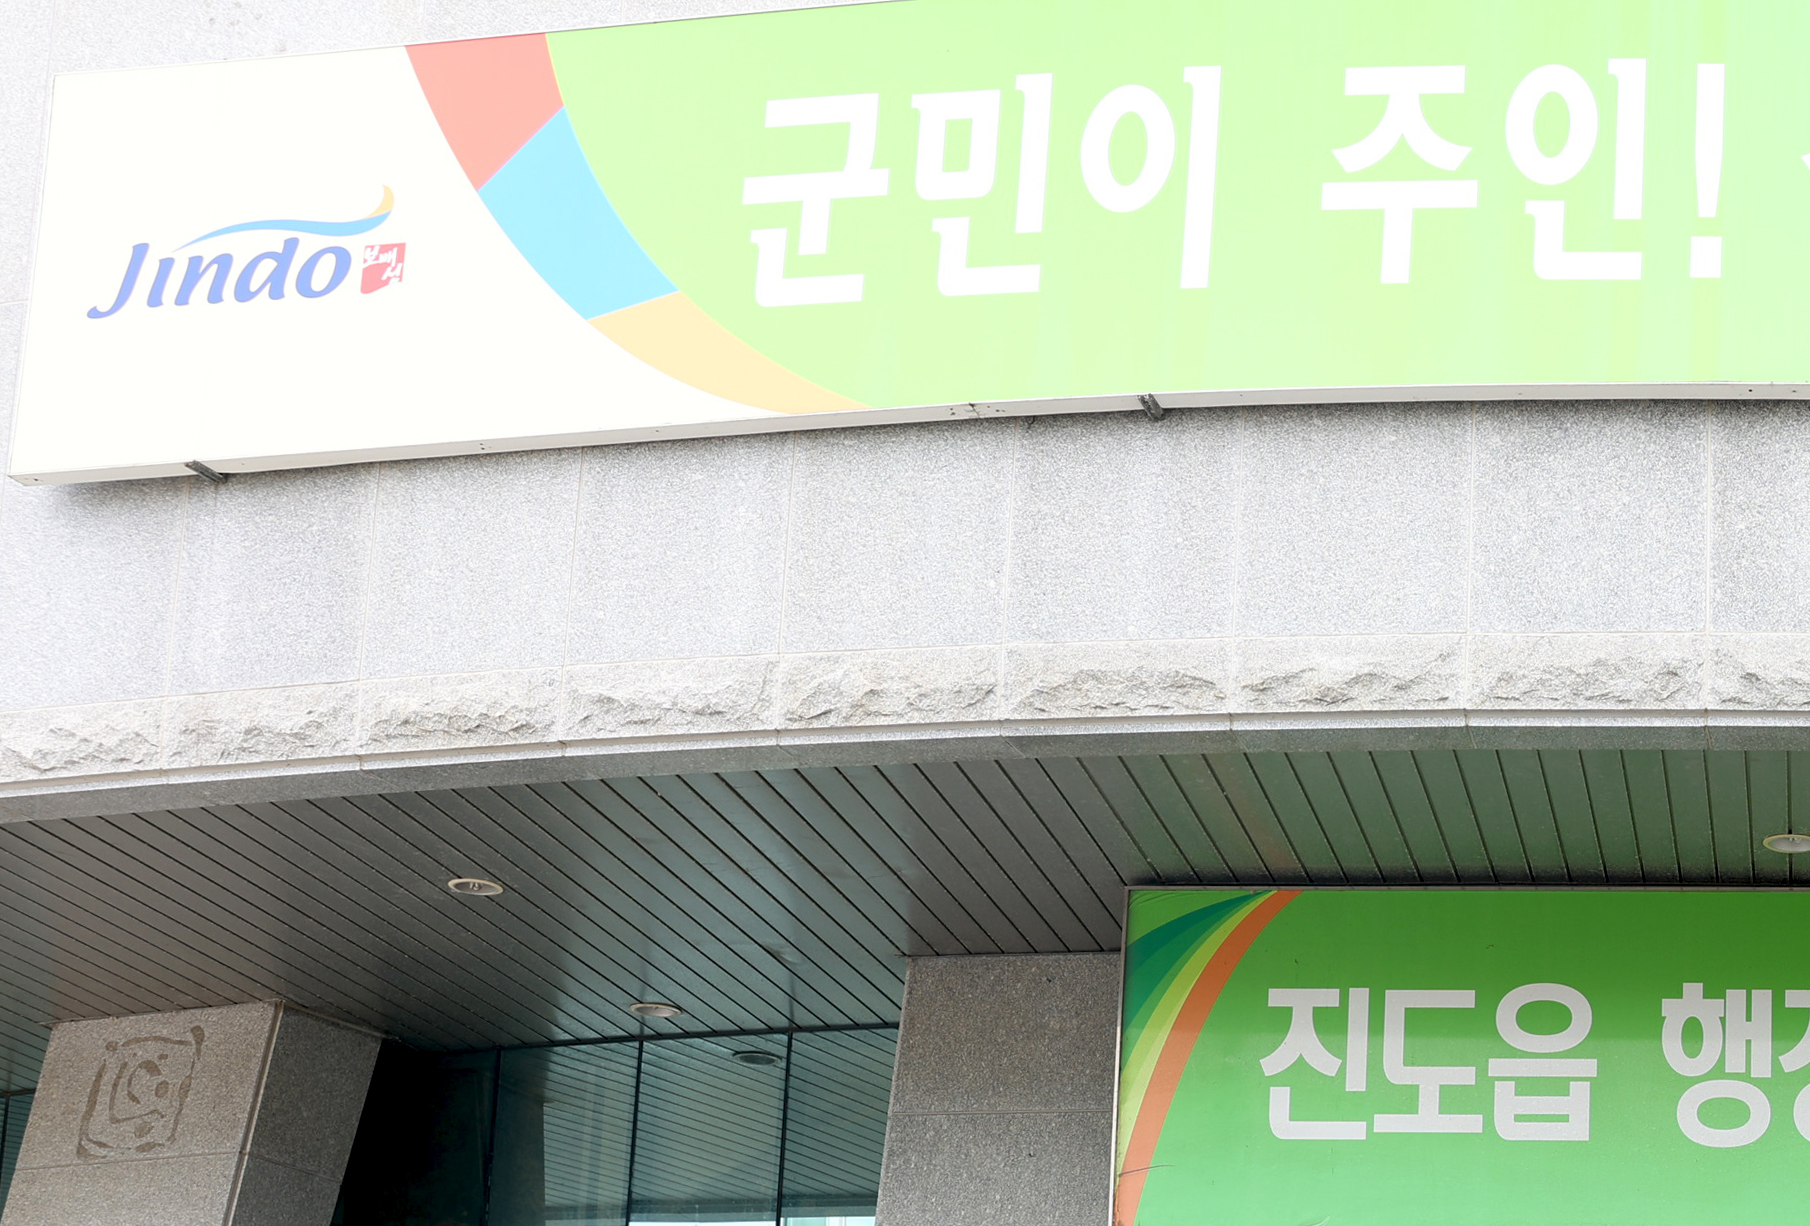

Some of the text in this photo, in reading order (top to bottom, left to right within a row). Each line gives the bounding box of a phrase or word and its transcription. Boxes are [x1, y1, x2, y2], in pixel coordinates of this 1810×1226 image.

[742, 65, 1222, 307] 군민이
[1320, 58, 1726, 285] 주인!
[86, 236, 352, 319] Jindo
[1259, 982, 1600, 1141] 진도읍
